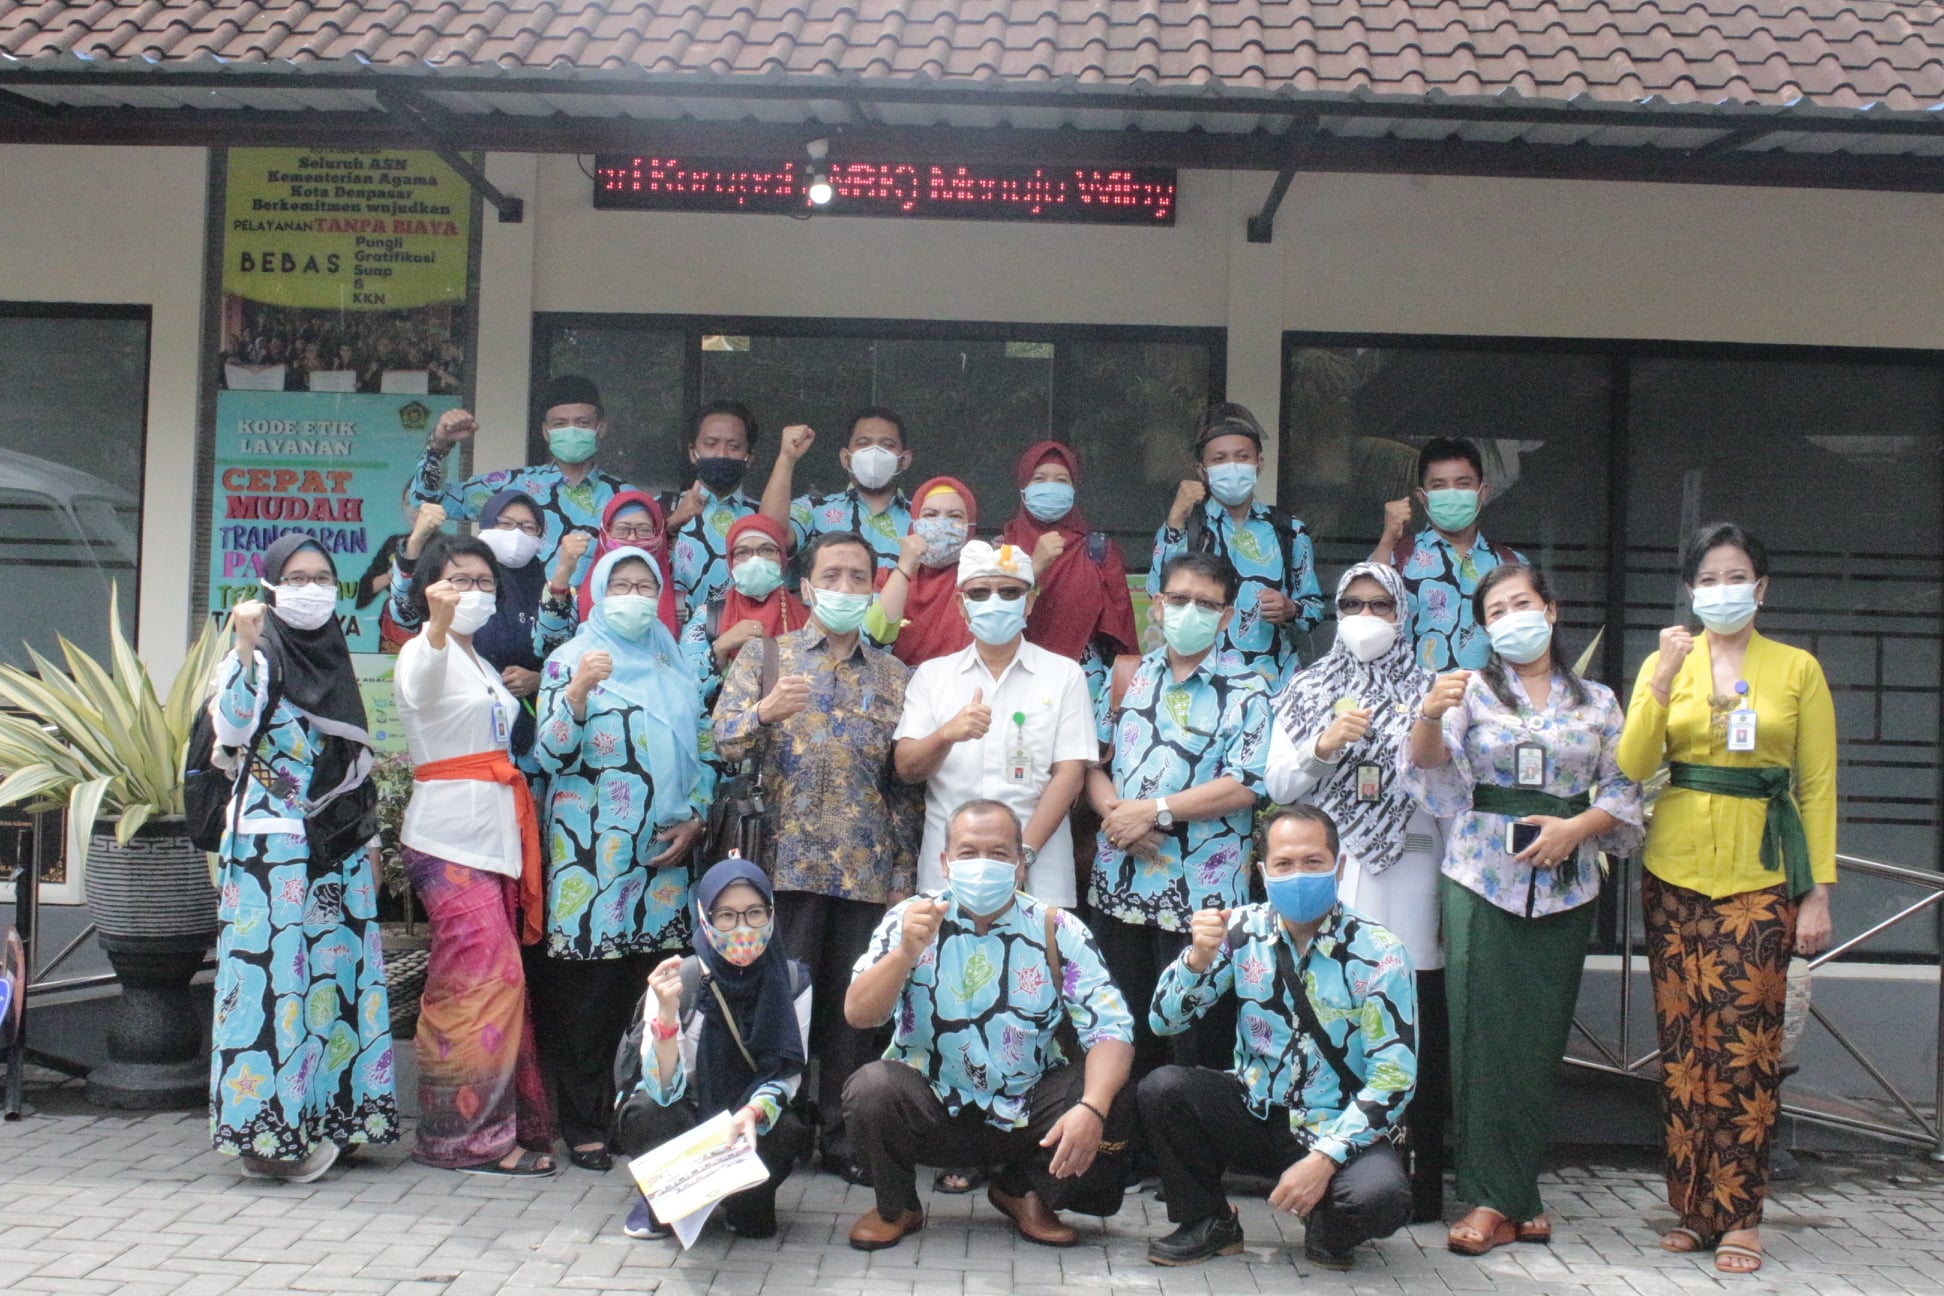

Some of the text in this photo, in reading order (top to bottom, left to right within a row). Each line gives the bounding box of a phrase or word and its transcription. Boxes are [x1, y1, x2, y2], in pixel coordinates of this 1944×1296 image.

[299, 156, 408, 171] Seluruh ASN
[267, 170, 438, 187] Kementerian Agama
[291, 185, 414, 200] Kota Denpasar
[252, 198, 450, 216] Berkomitmen wujudkan
[233, 217, 459, 236] PELAYANAN TANPA BIAYA
[355, 236, 404, 252] Pungli
[240, 251, 341, 274] BEBAS
[354, 250, 436, 264] Gratifikasi
[353, 264, 393, 279] Suap
[352, 292, 386, 304] KKN
[237, 419, 357, 436] KODE ETIK
[240, 439, 352, 456] LAYANAN
[222, 467, 353, 494] CEPAT
[225, 495, 364, 522] MUDAH
